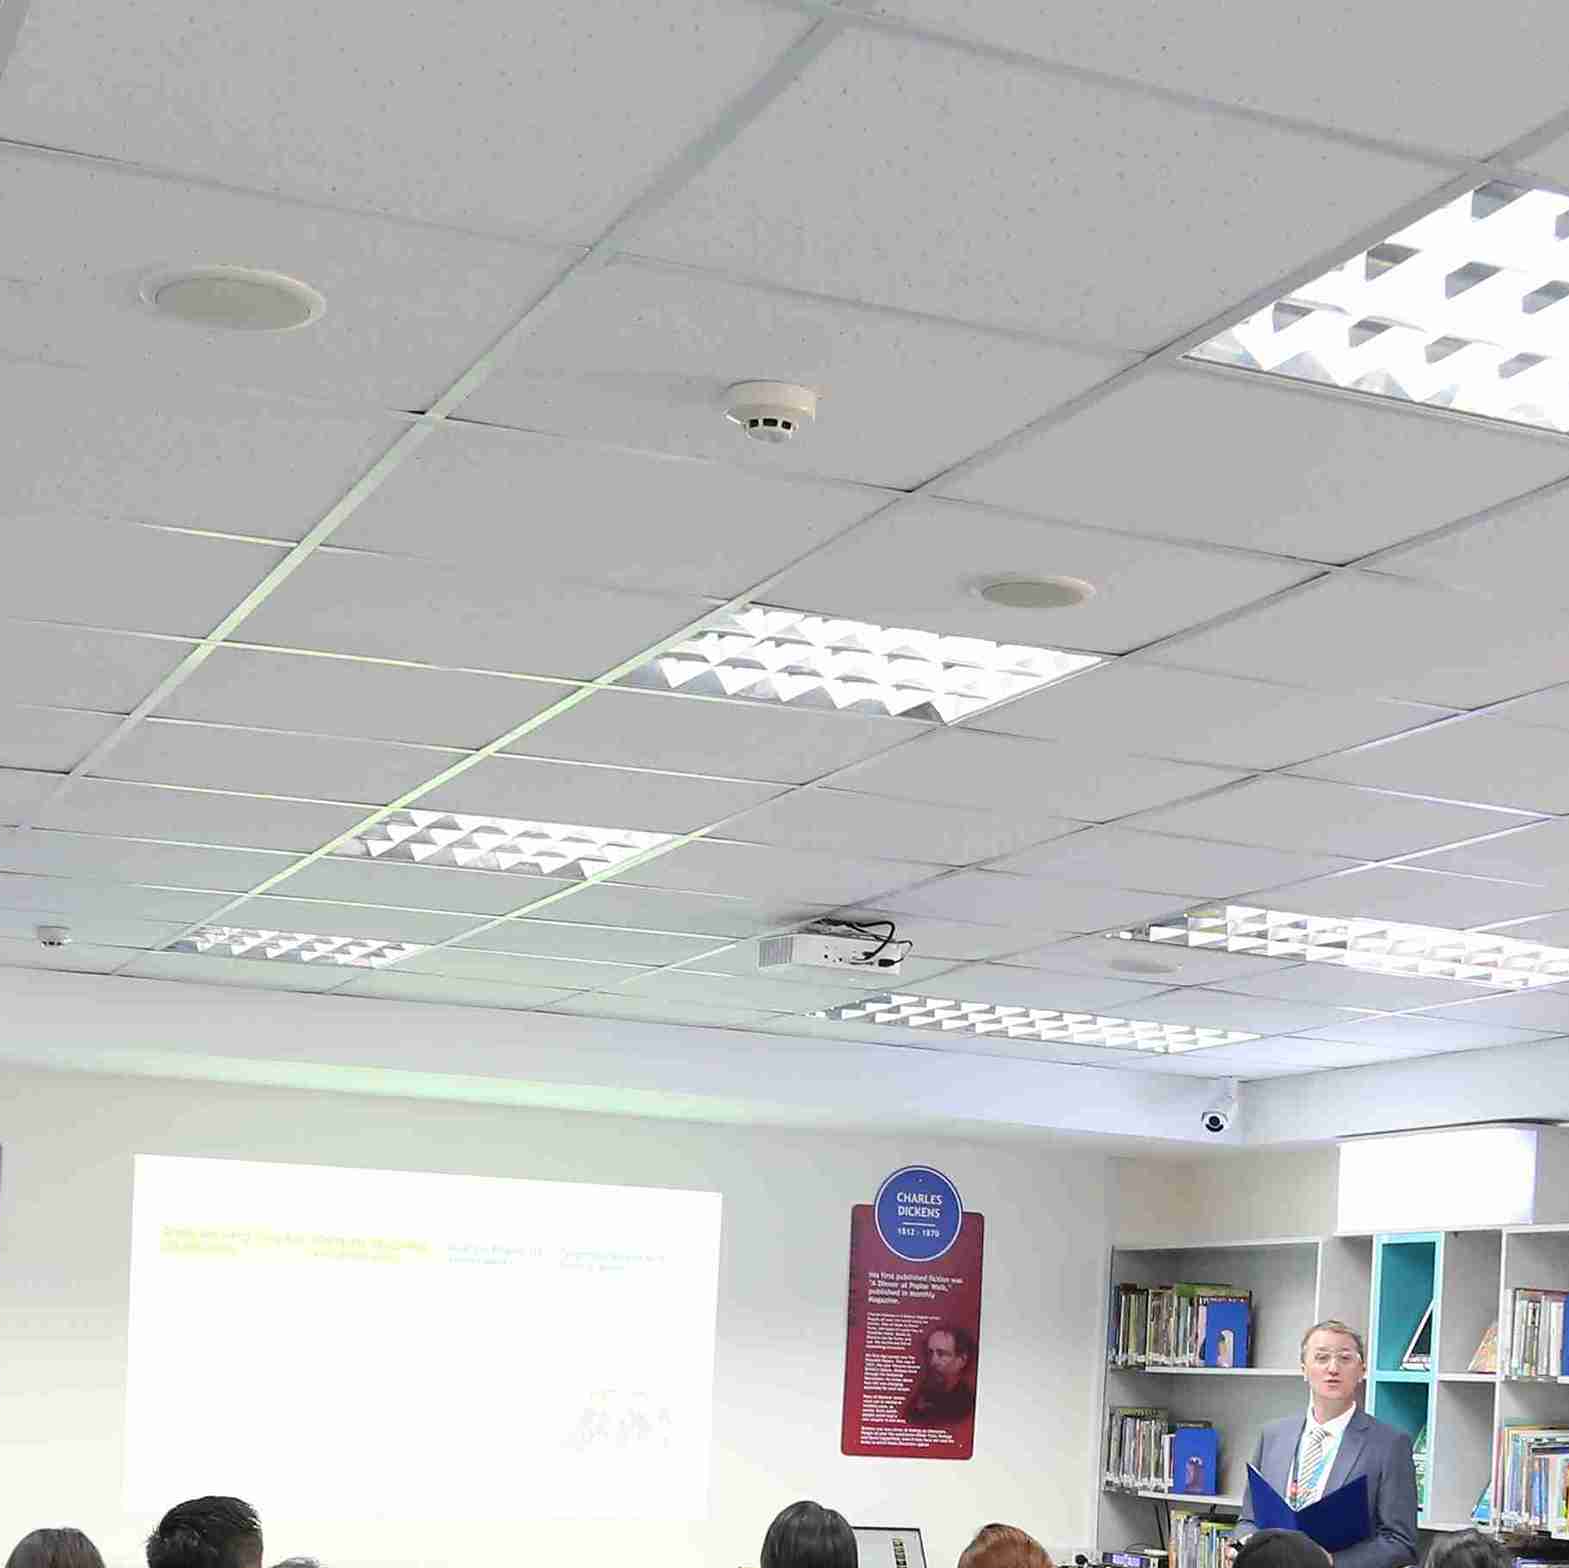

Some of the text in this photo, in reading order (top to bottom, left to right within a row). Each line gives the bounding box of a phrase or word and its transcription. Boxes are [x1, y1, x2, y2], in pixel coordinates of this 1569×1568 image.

[896, 1191, 943, 1206] CHARLES
[897, 1205, 941, 1219] DICKENS
[897, 1227, 915, 1236] 1812
[922, 1229, 940, 1238] 1870
